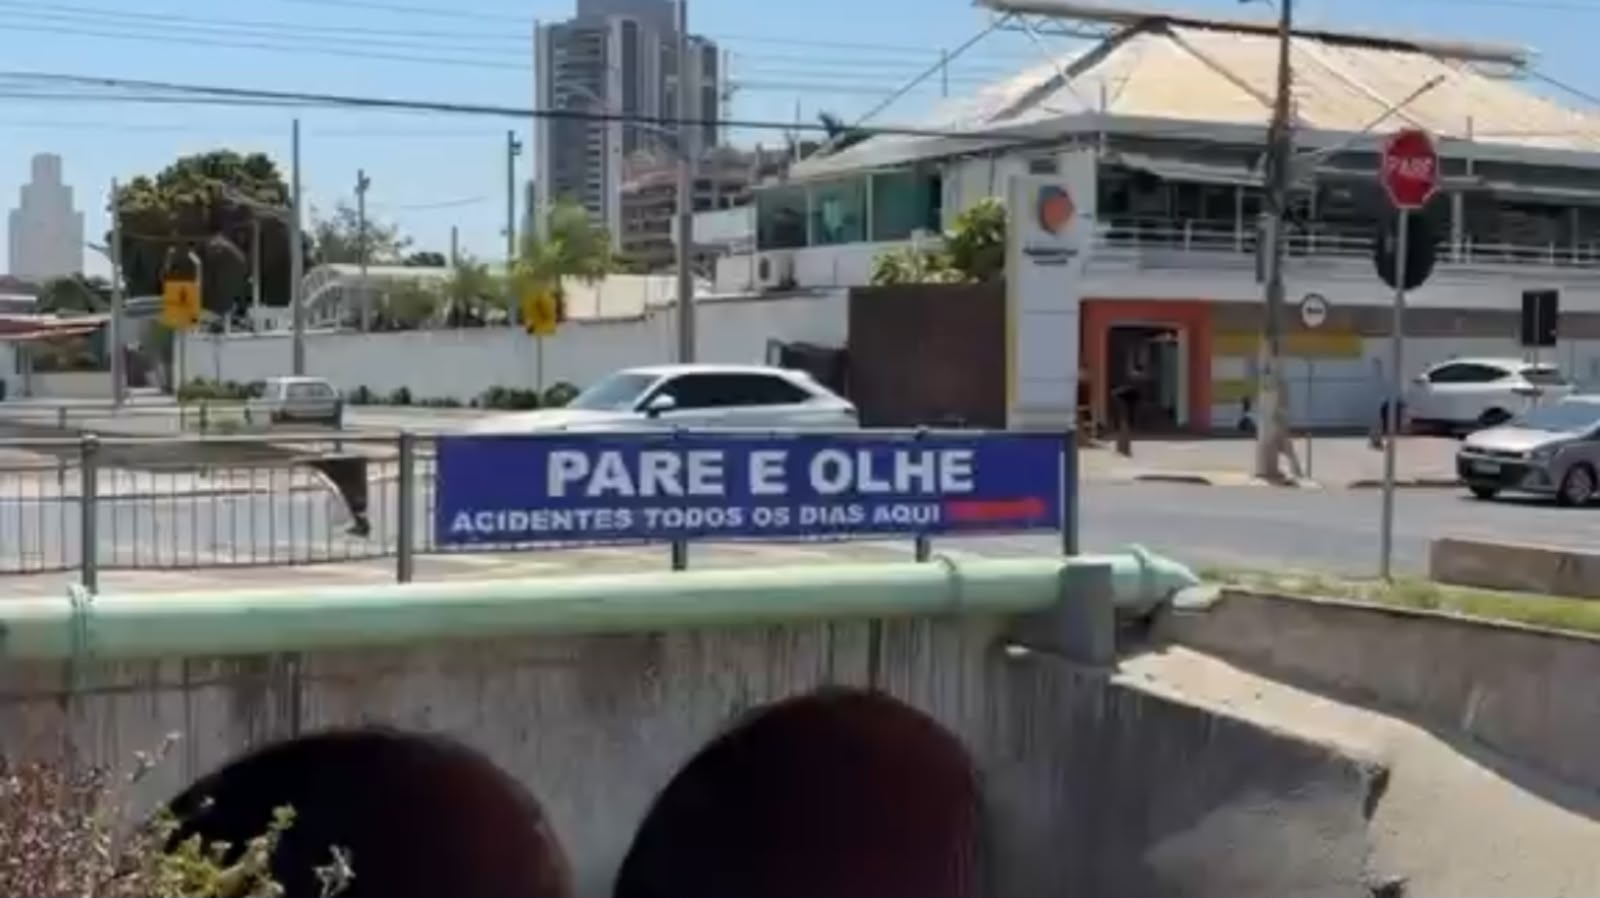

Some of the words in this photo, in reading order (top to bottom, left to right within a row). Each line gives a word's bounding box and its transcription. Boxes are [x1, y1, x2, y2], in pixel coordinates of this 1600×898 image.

[547, 450, 725, 498] PARE
[750, 450, 789, 495] E
[809, 449, 975, 494] OLHE
[451, 508, 634, 533] ACIDENTES
[644, 506, 743, 529] TODOS
[752, 506, 791, 527] OS
[799, 503, 865, 525] DIAS
[872, 504, 941, 524] AQUI
